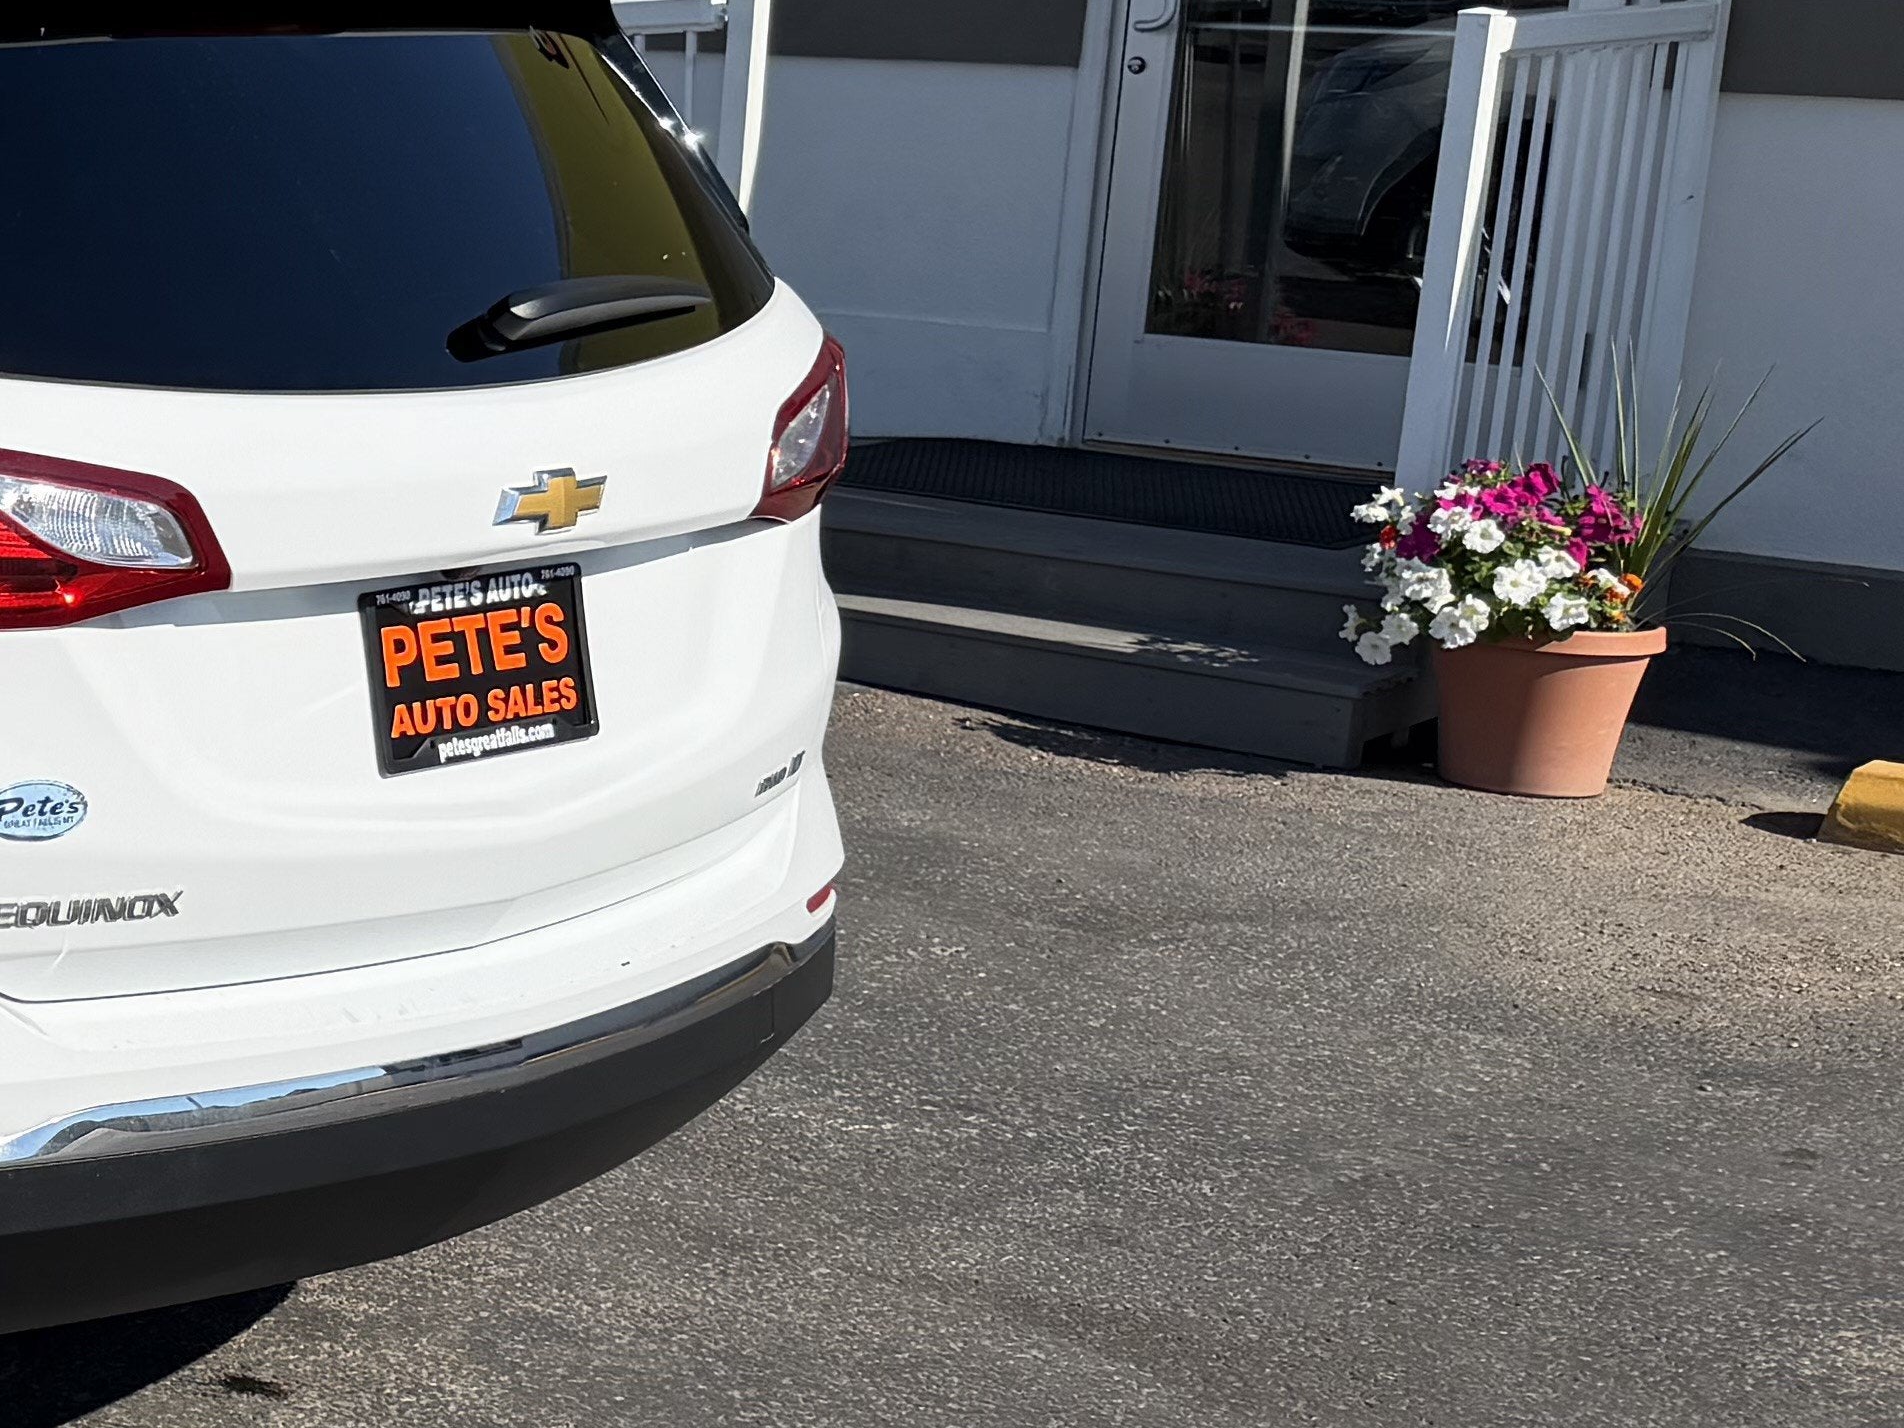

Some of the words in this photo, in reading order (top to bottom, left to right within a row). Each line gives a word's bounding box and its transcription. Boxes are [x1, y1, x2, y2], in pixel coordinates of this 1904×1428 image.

[417, 580, 483, 613] PETE'S
[486, 572, 534, 604] AUTO
[380, 602, 569, 688] PETE'S
[391, 694, 479, 738] AUTO
[487, 676, 578, 721] SALES
[438, 723, 555, 763] petesgreatfalls.com
